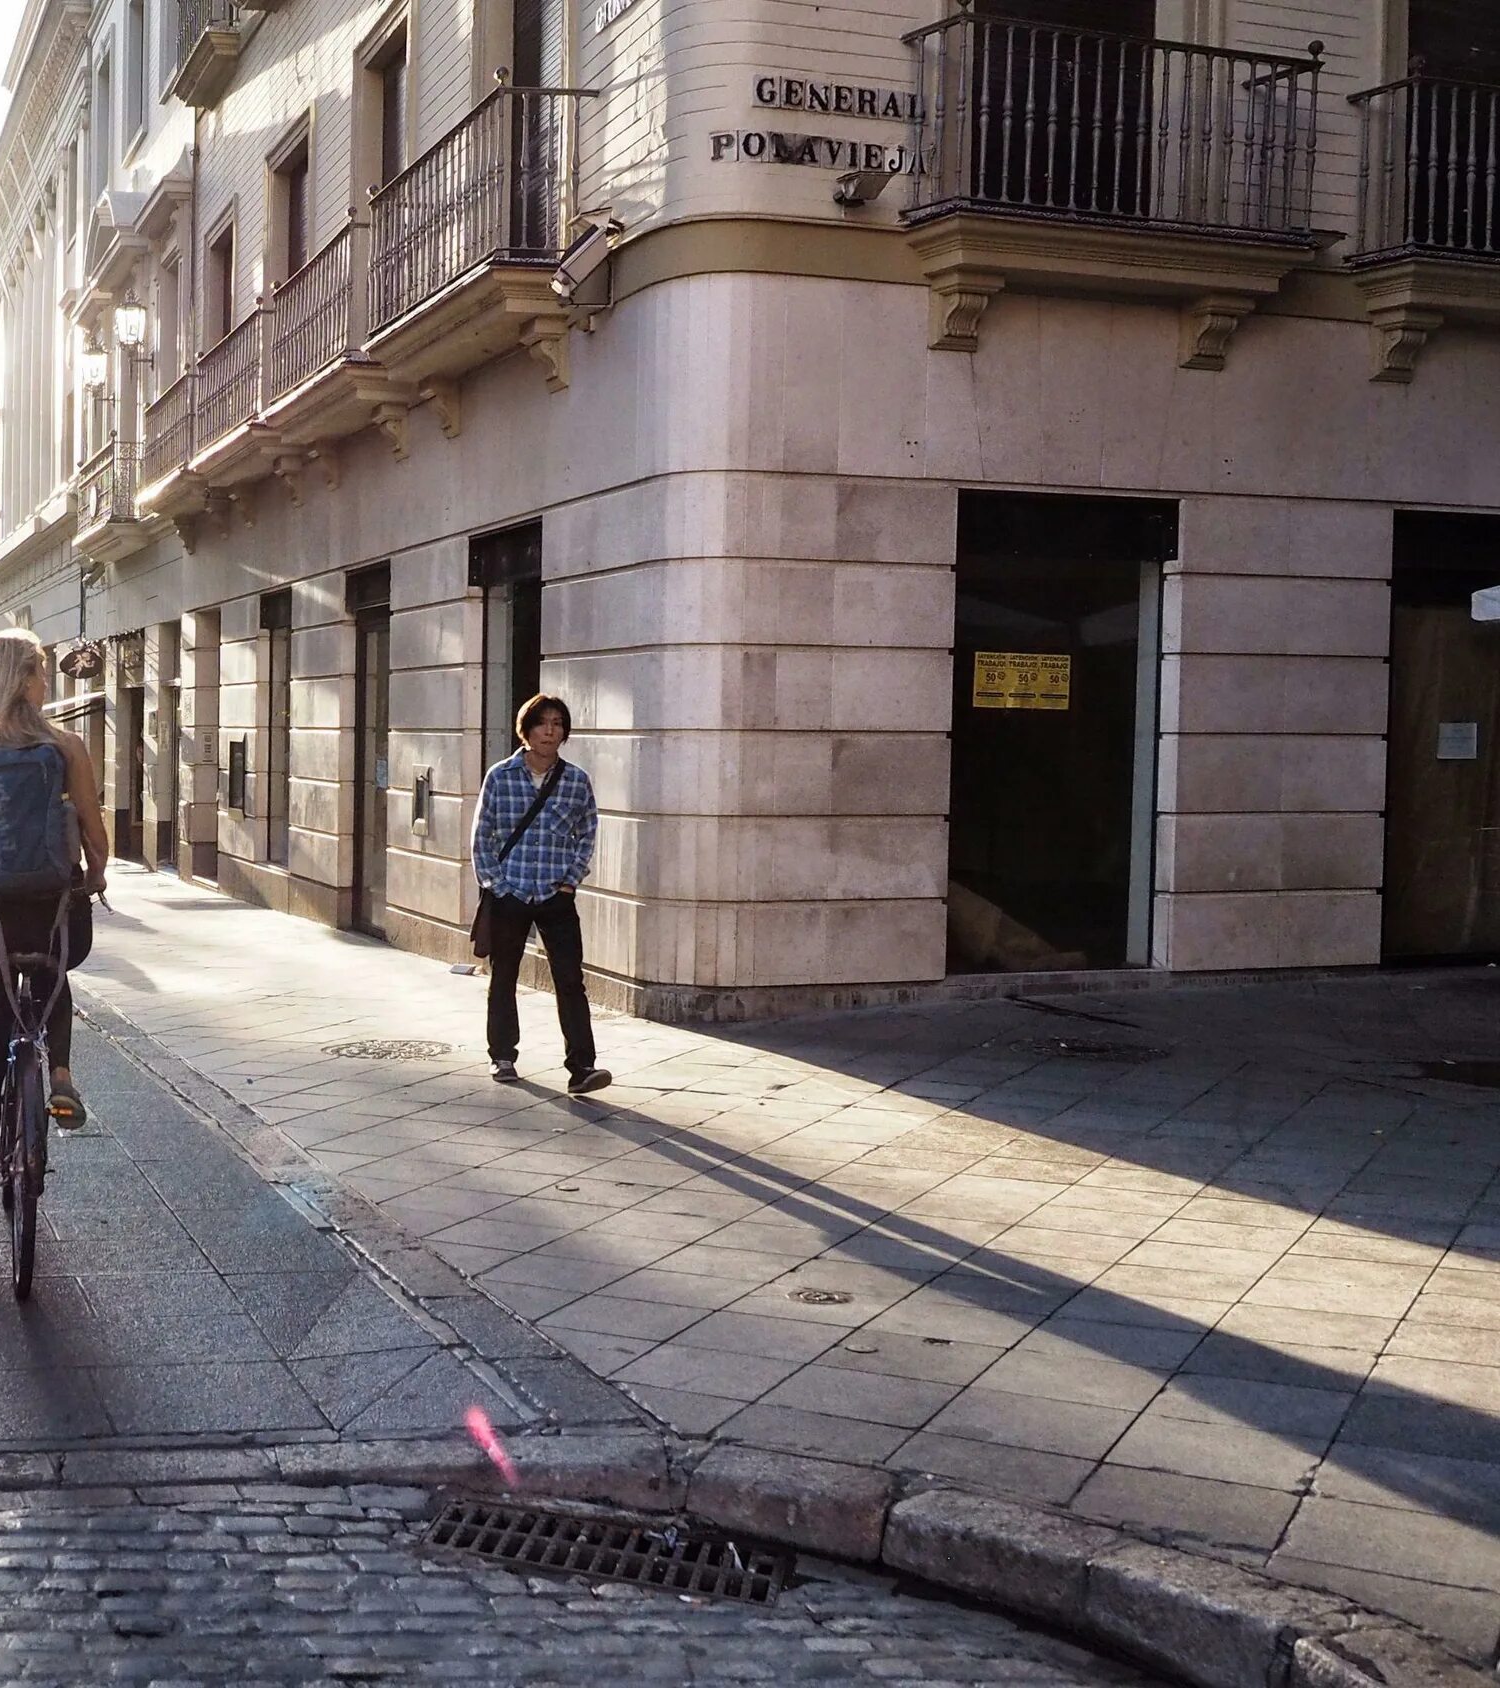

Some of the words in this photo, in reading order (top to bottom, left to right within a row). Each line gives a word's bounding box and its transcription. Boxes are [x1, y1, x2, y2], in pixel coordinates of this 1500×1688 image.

[755, 77, 926, 120] GENERAL
[986, 672, 996, 682] 50
[1018, 674, 1029, 683] 50
[1050, 675, 1060, 684] 50
